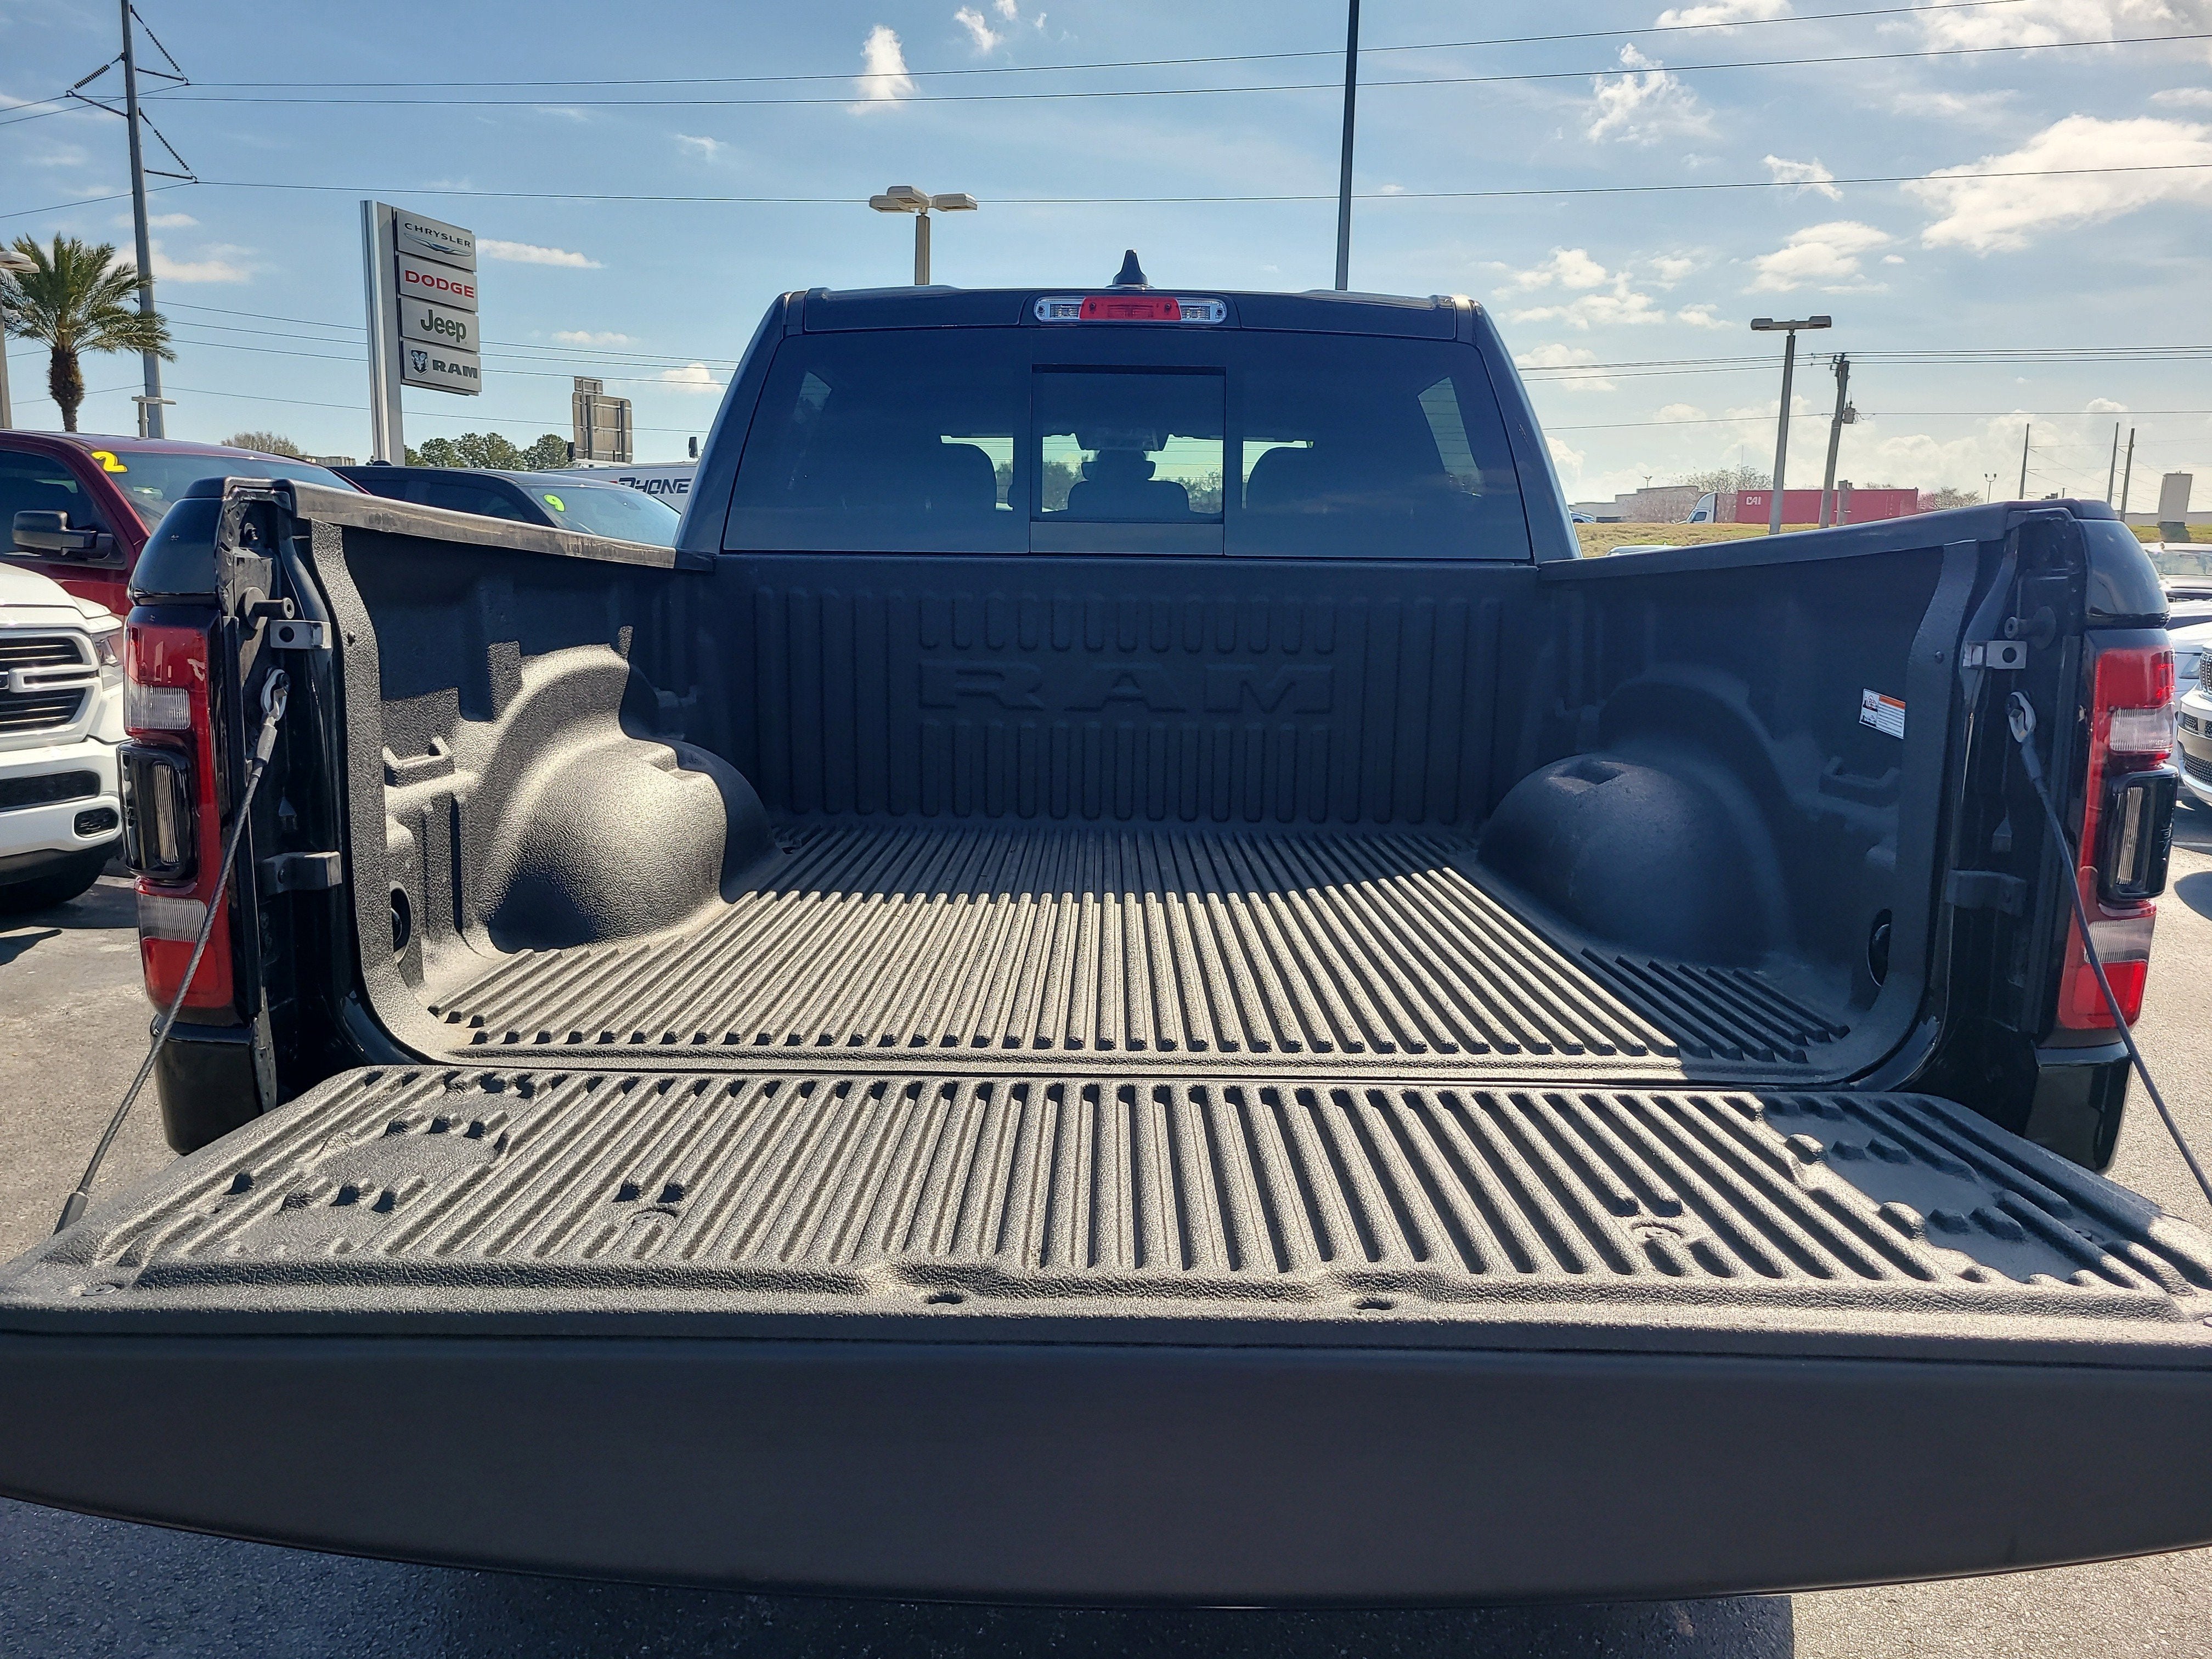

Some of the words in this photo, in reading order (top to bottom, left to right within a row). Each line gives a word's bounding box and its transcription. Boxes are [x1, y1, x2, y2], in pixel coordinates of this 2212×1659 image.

[404, 223, 471, 247] CHRYSLER
[405, 270, 475, 298] DODGE
[420, 309, 466, 342] Jeep
[432, 359, 478, 379] RAM
[91, 451, 128, 472] 2
[1746, 496, 1762, 505] CAI
[918, 662, 1333, 713] RAM
